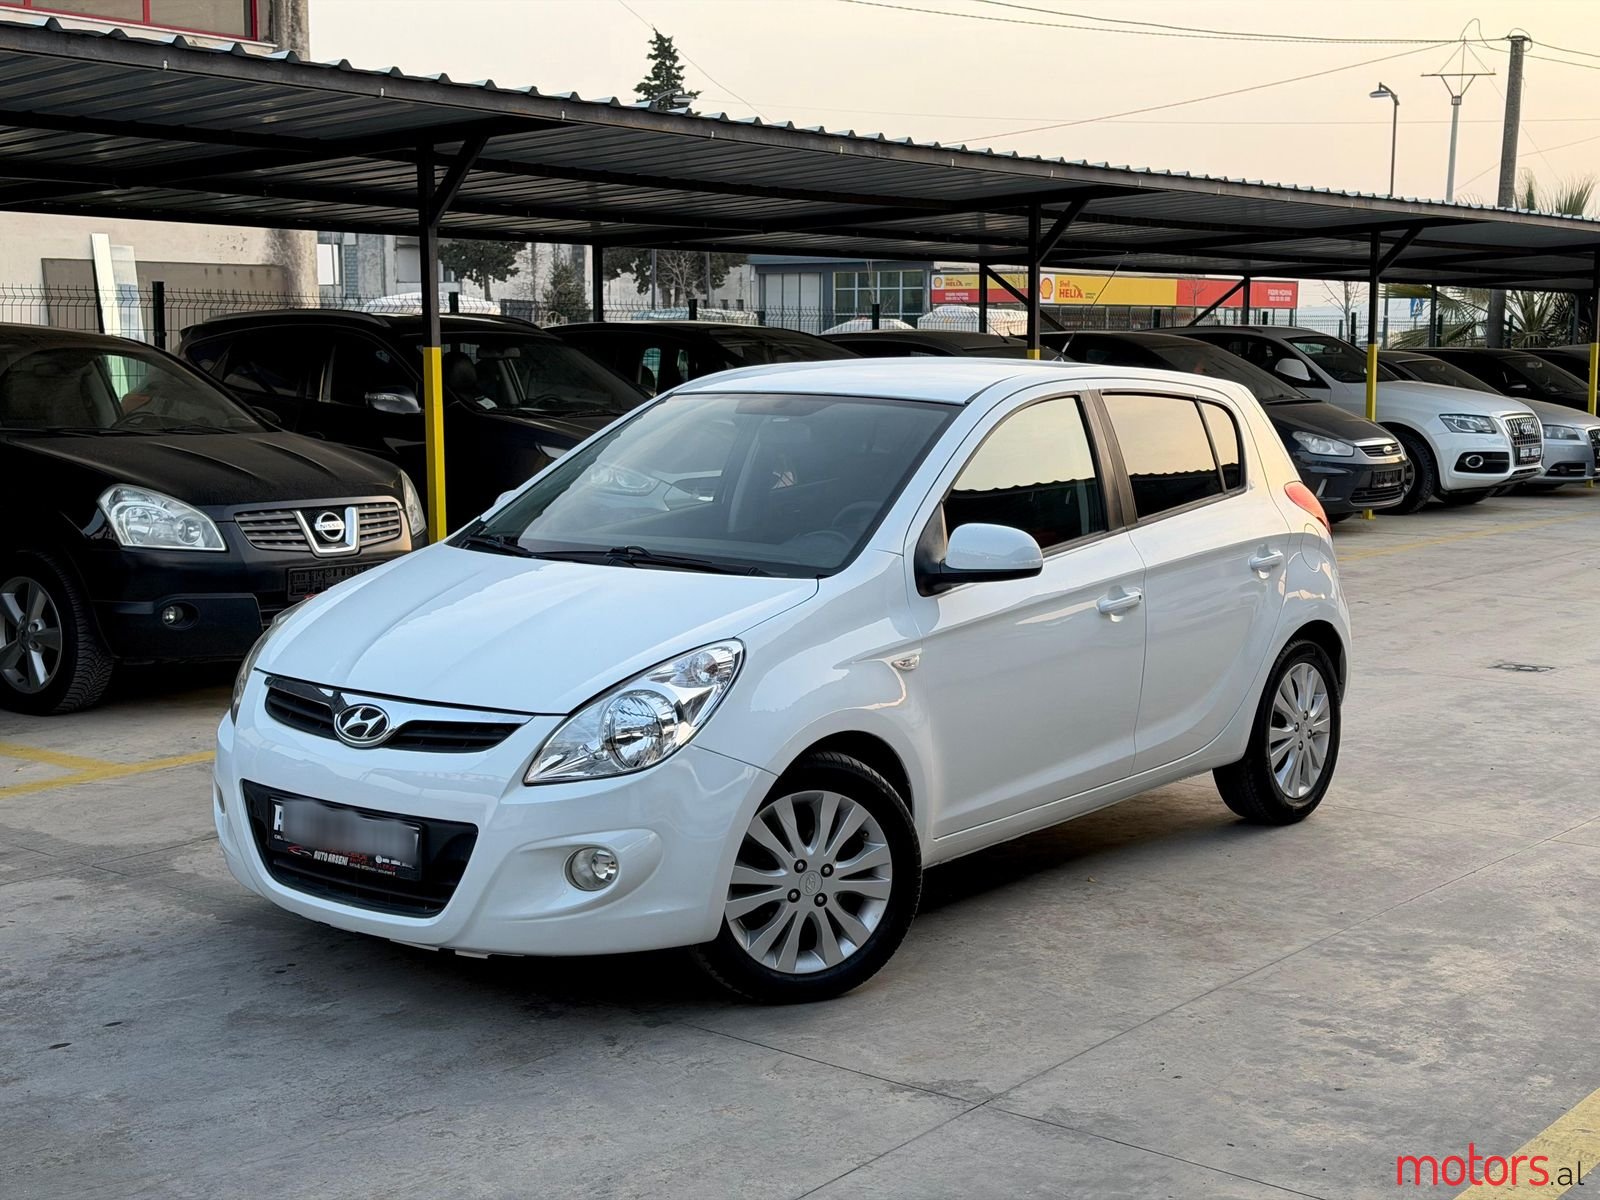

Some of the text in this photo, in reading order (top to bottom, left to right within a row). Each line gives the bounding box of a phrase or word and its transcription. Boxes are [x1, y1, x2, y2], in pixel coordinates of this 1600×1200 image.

[1059, 280, 1071, 288] Shell
[1058, 287, 1083, 299] HELIX
[314, 850, 328, 862] AUTO
